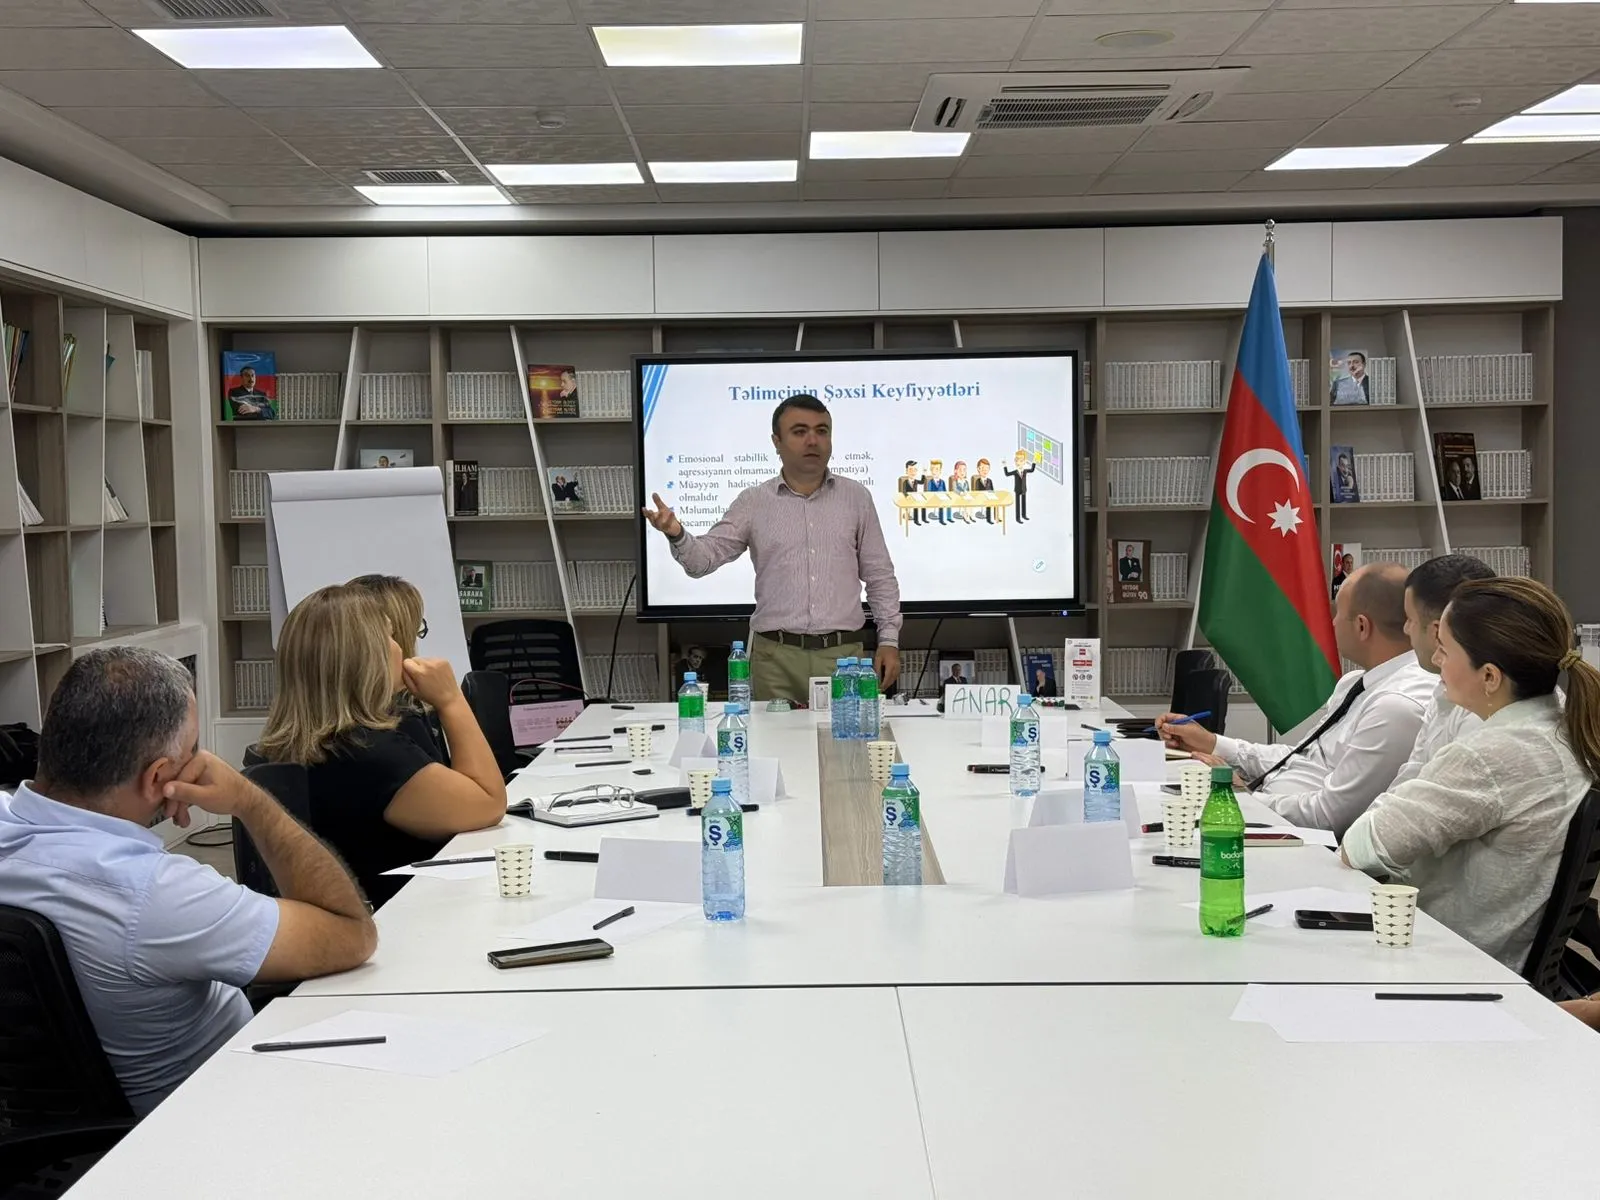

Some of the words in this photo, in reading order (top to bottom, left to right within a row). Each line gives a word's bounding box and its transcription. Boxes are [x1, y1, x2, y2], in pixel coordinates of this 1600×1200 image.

[824, 384, 866, 402] Şəxsi
[872, 382, 980, 401] Keyfiyyətləri
[678, 454, 724, 463] Emosional
[734, 454, 769, 463] stabillik
[829, 466, 869, 476] mpatiya)
[679, 480, 719, 490] Müəyyən
[679, 493, 718, 502] olmalıdır
[952, 687, 1014, 716] ANAR
